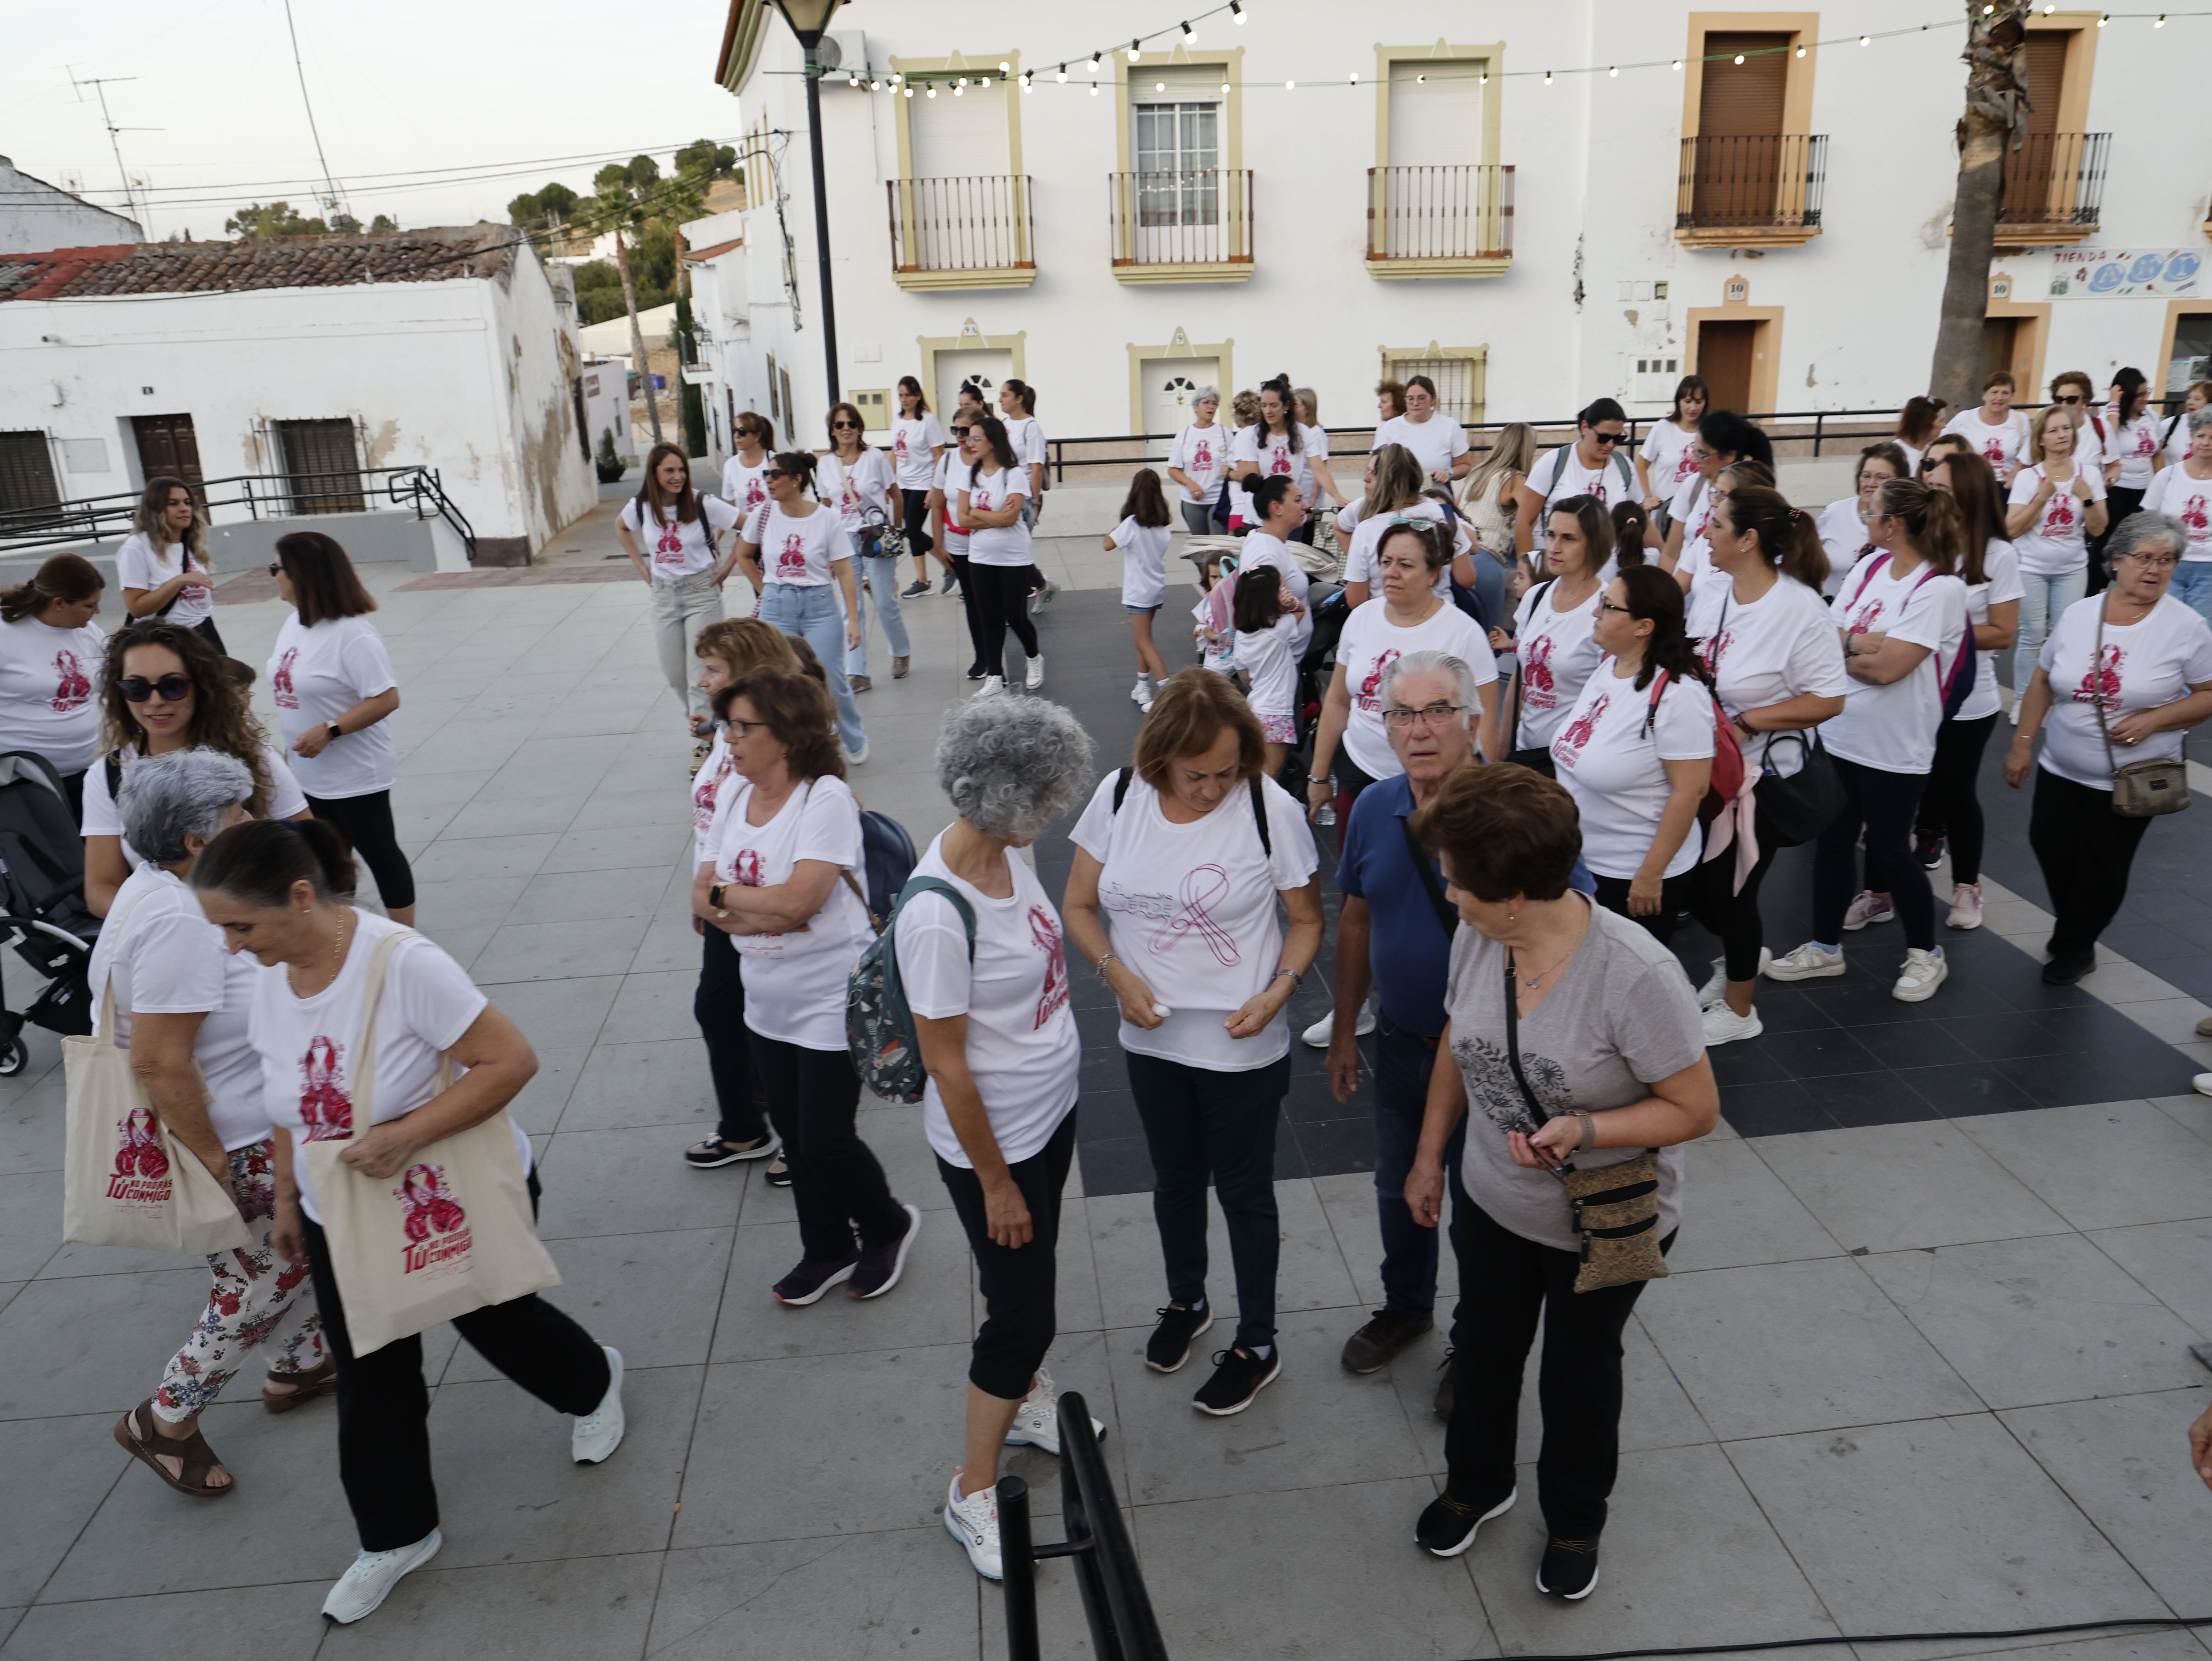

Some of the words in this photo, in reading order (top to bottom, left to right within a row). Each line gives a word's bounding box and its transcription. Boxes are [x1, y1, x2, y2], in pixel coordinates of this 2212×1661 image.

[2054, 251, 2107, 264] TIENDA
[1731, 284, 1743, 292] 10
[1994, 285, 2006, 294] 10
[1177, 334, 1183, 343] 9
[125, 1189, 171, 1203] CONMIGO
